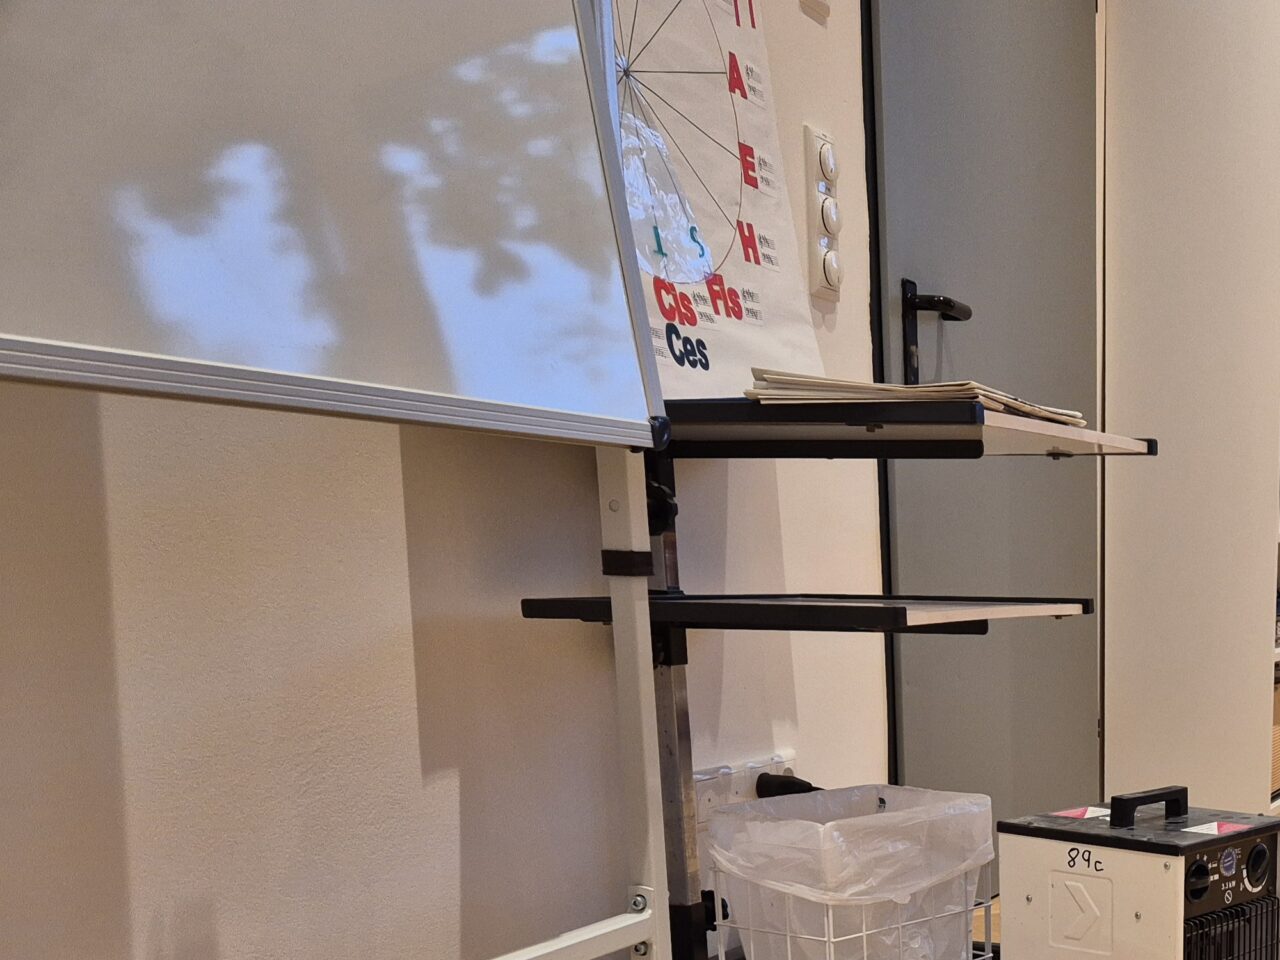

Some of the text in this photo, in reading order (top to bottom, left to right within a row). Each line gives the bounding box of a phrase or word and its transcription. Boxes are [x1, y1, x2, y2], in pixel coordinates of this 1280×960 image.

[728, 51, 748, 100] A
[738, 141, 759, 190] E
[736, 219, 762, 266] H
[652, 275, 698, 327] Cis
[704, 273, 743, 321] Fis
[665, 322, 710, 371] Ces
